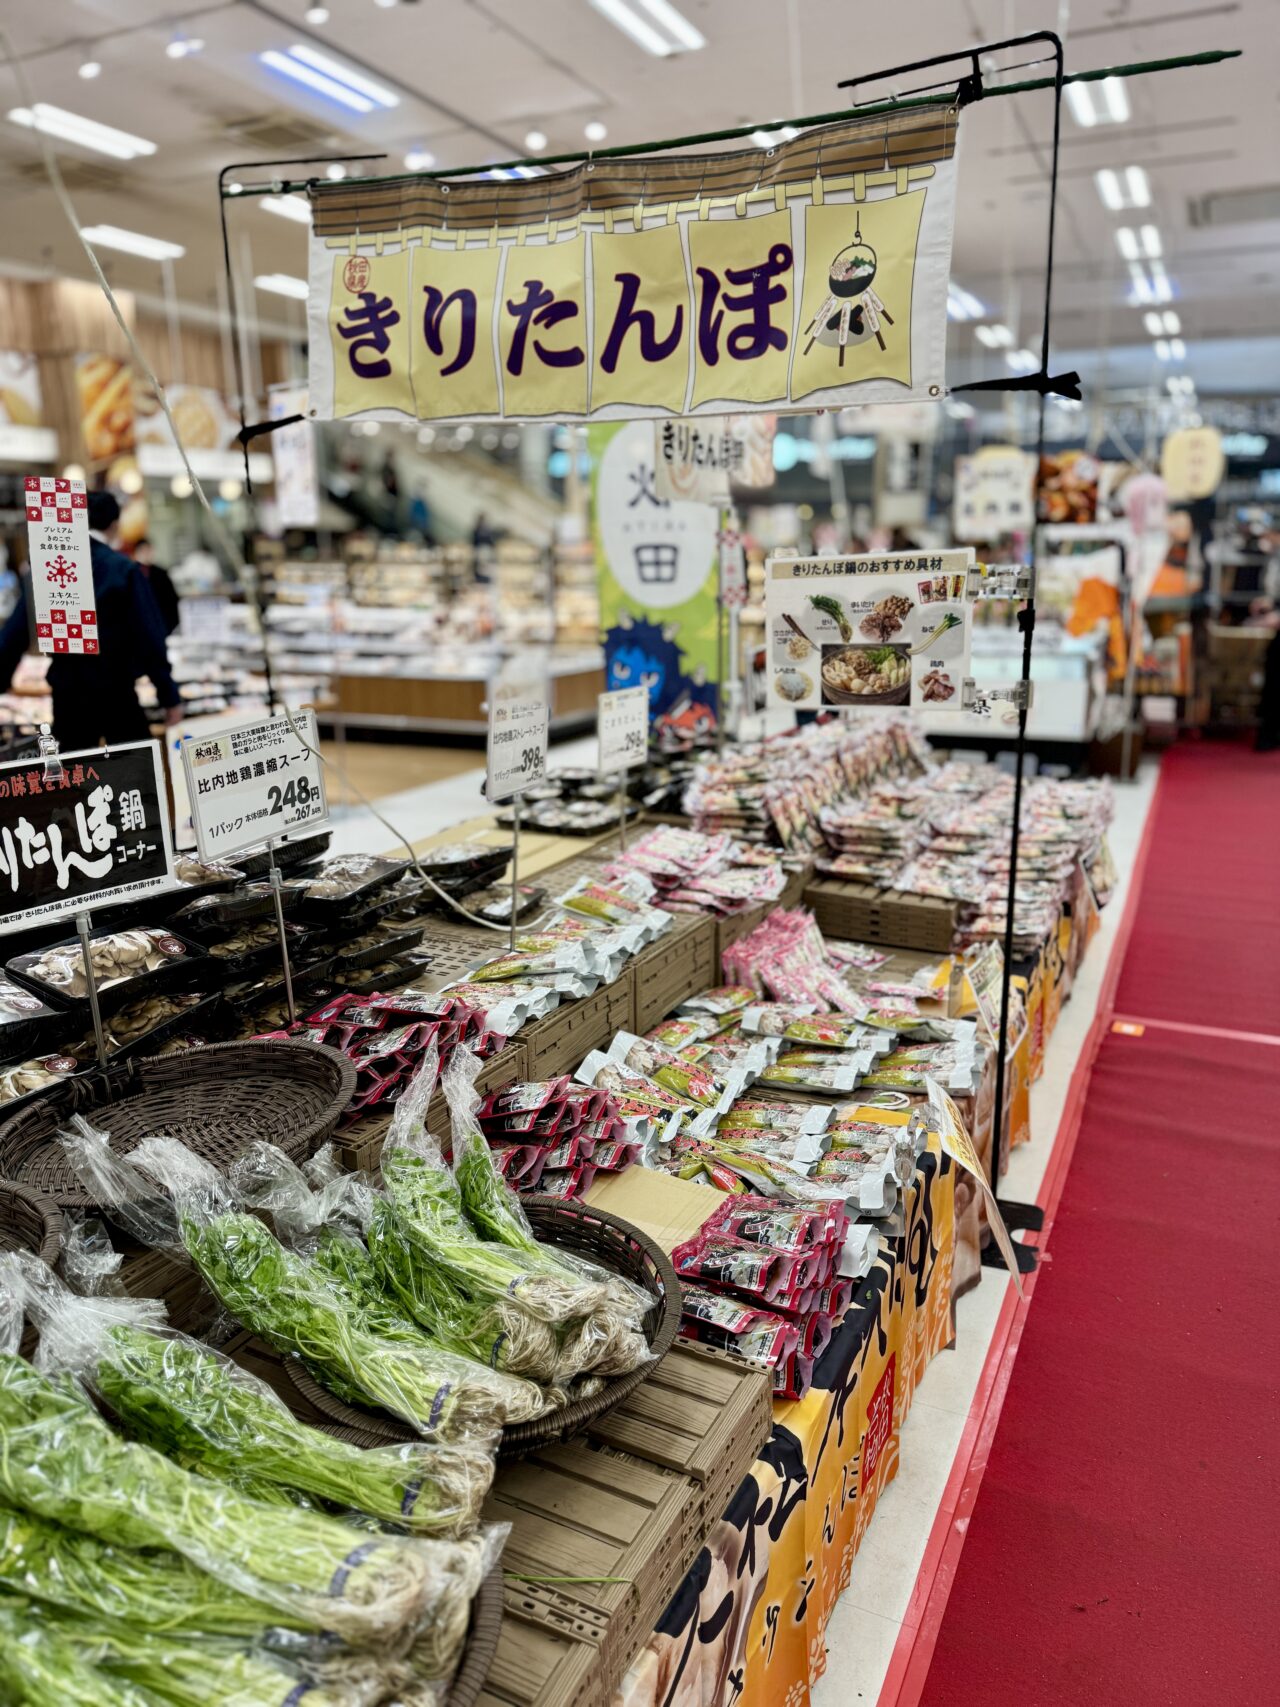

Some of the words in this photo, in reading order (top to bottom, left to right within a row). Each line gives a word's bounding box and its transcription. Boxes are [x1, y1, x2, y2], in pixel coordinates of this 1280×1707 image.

[336, 243, 793, 379] きりたんぽ
[43, 526, 73, 534] プレミアム
[40, 543, 80, 551] 食卓を豊かに
[198, 748, 310, 794] 比内地鶏濃縮スープ
[118, 789, 146, 832] 鍋
[117, 840, 157, 863] コーナー
